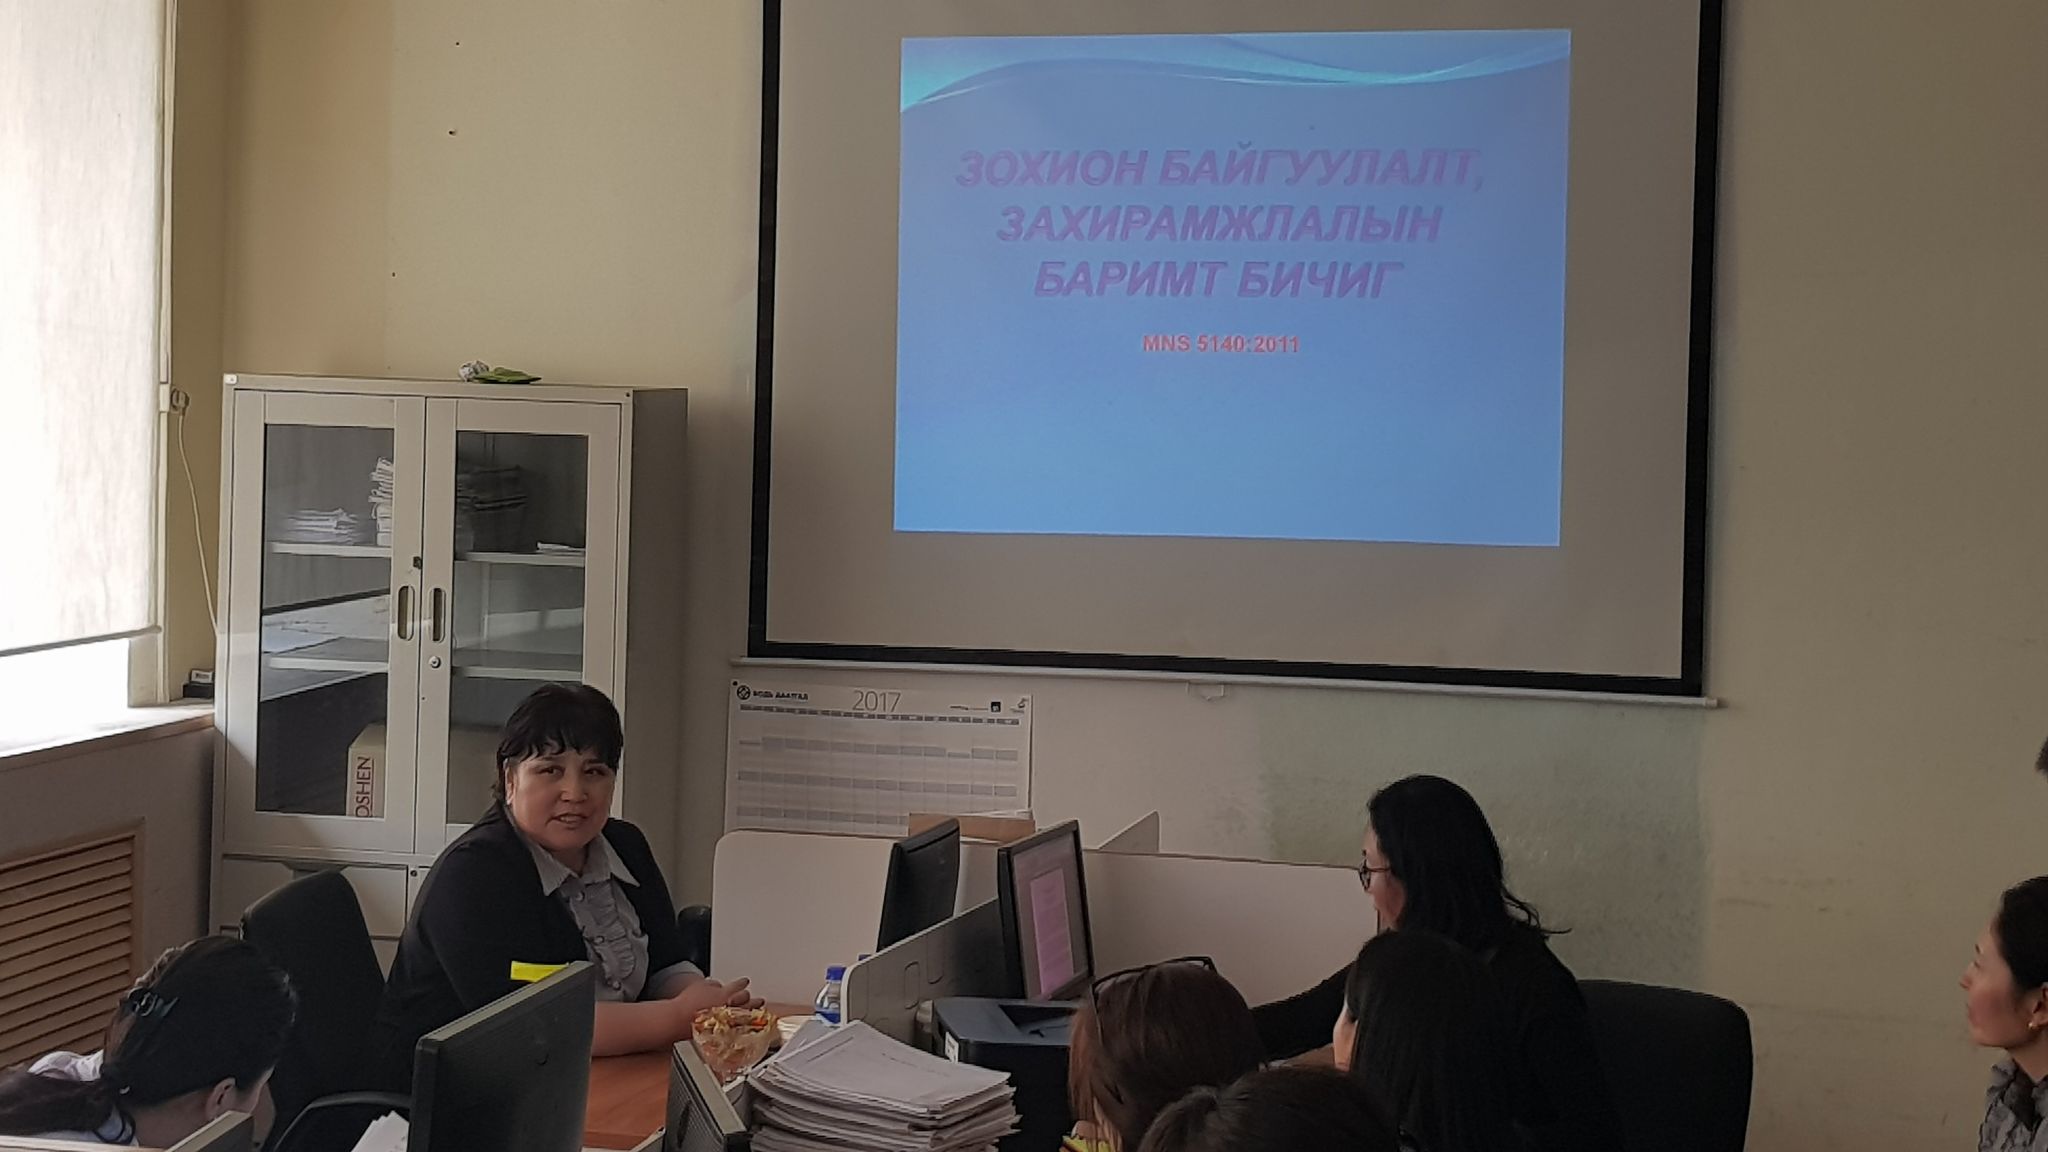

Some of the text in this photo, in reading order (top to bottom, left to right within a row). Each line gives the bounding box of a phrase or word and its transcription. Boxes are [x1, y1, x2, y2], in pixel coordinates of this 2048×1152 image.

[956, 141, 1484, 192] ЗОХИОН БАЙГУУЛАЛТ,
[996, 204, 1443, 242] ЗАХИРАМЖЛАЛЫН
[1034, 260, 1405, 298] БАРИМТ БИЧИГ
[1143, 334, 1299, 352] MNS 5140:2011
[852, 690, 901, 712] 2017
